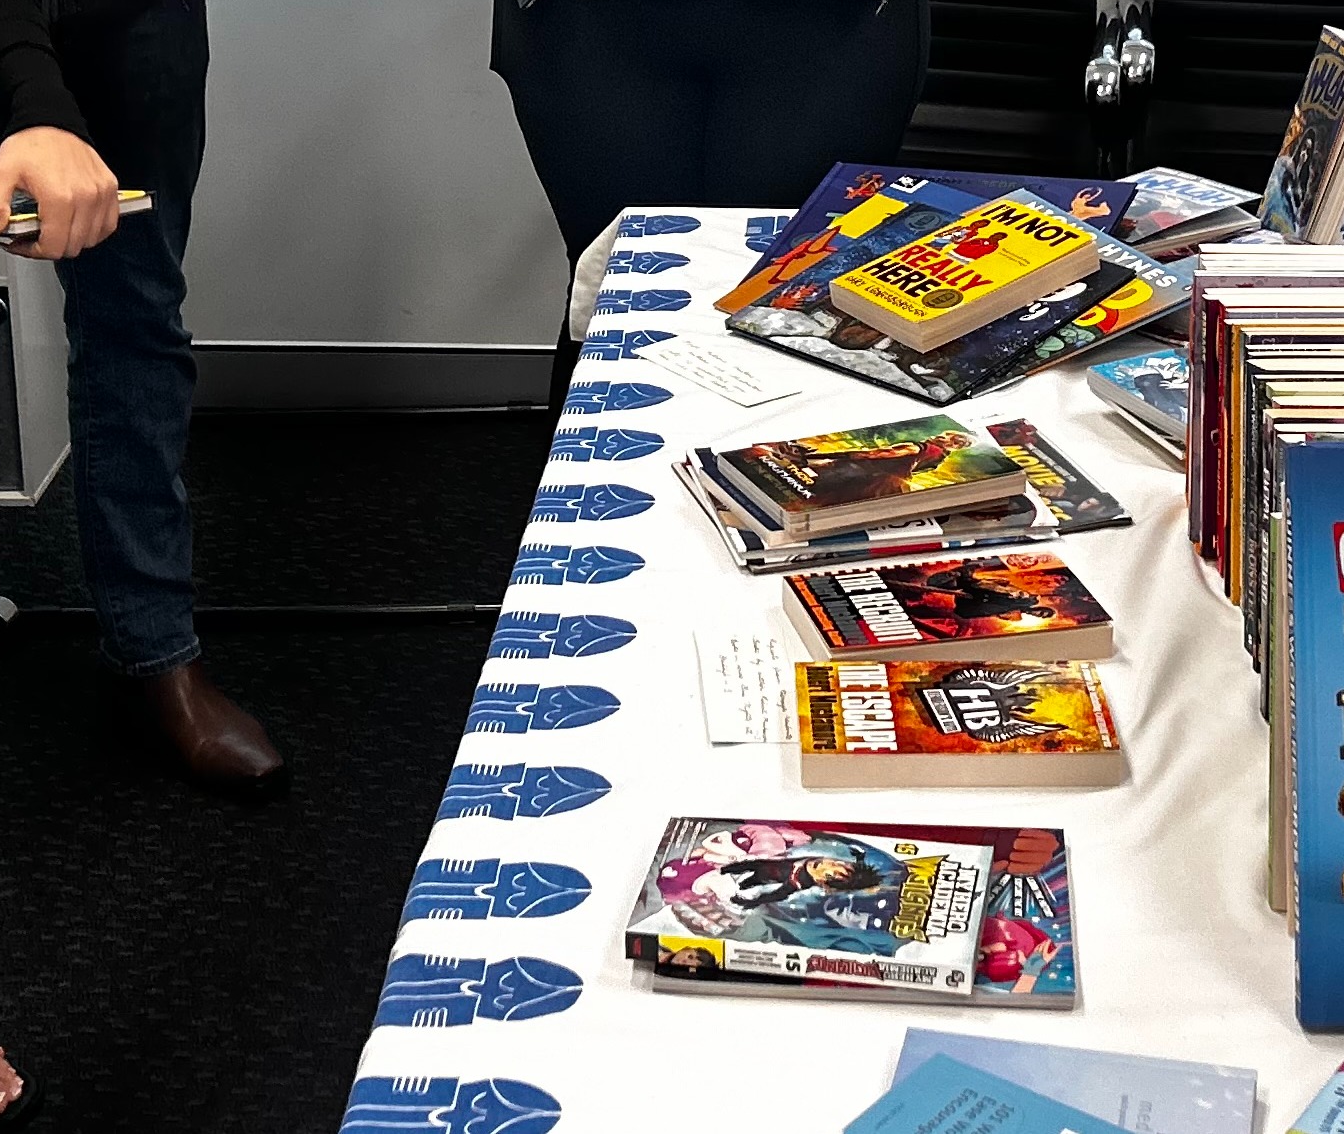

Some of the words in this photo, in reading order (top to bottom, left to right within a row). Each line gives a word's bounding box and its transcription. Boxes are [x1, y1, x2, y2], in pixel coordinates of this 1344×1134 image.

[980, 203, 1026, 226] I'M
[1015, 217, 1080, 248] NOT
[862, 258, 941, 298] HERE
[894, 244, 994, 293] REALLY
[1097, 242, 1178, 288] HYNES
[787, 463, 815, 486] THOR
[1001, 445, 1066, 486] MOVIE
[835, 571, 888, 593] THE
[849, 591, 923, 642] RECRUIT
[837, 664, 889, 688] THE
[840, 690, 898, 752] ESCAPE
[948, 688, 1000, 730] HB
[925, 860, 958, 936] ACADEMIA
[955, 868, 976, 891] MY
[947, 890, 972, 932] HERO
